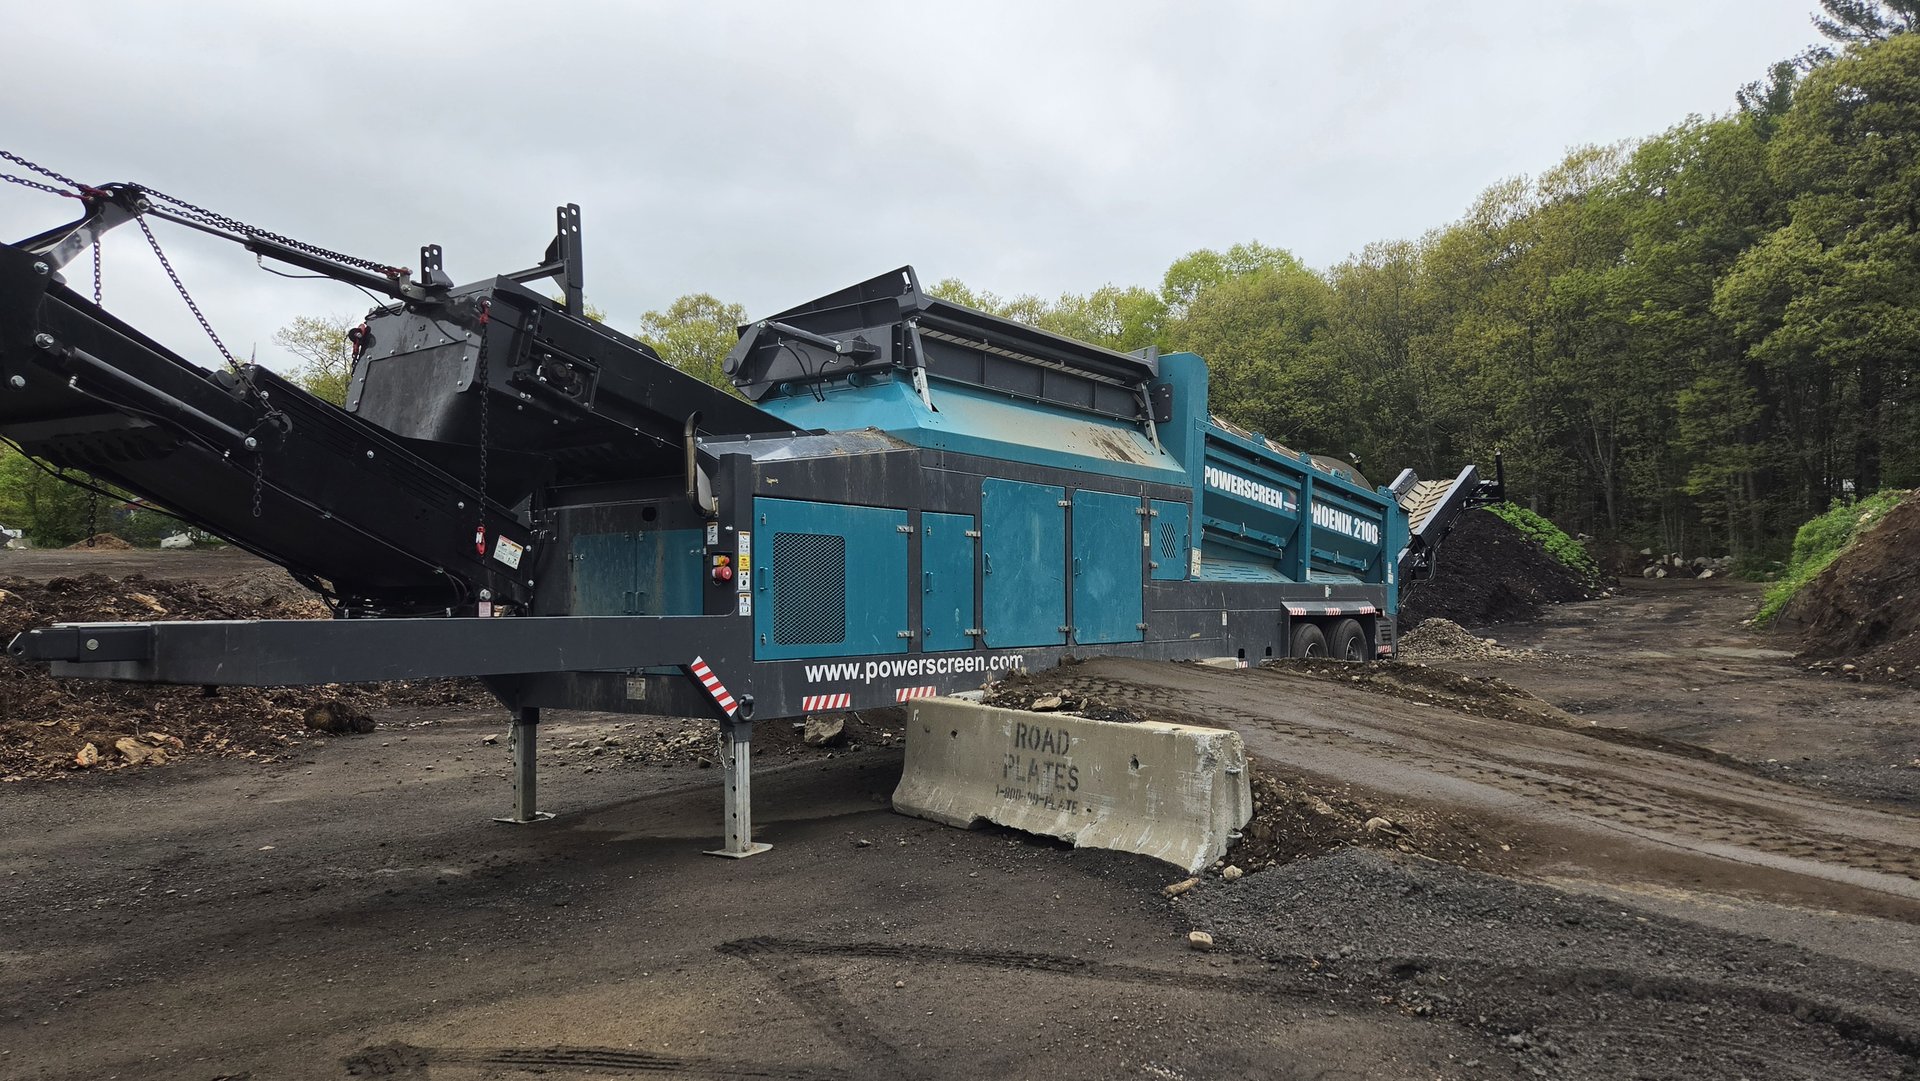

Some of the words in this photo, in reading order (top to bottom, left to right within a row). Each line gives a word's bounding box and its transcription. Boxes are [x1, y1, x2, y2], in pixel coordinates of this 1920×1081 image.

[1204, 465, 1283, 510] POWERSCREEN
[1353, 517, 1379, 545] 2100
[805, 654, 1024, 684] www.powerscreen.com
[1015, 722, 1070, 756] ROAD
[1002, 753, 1080, 793] PLATES
